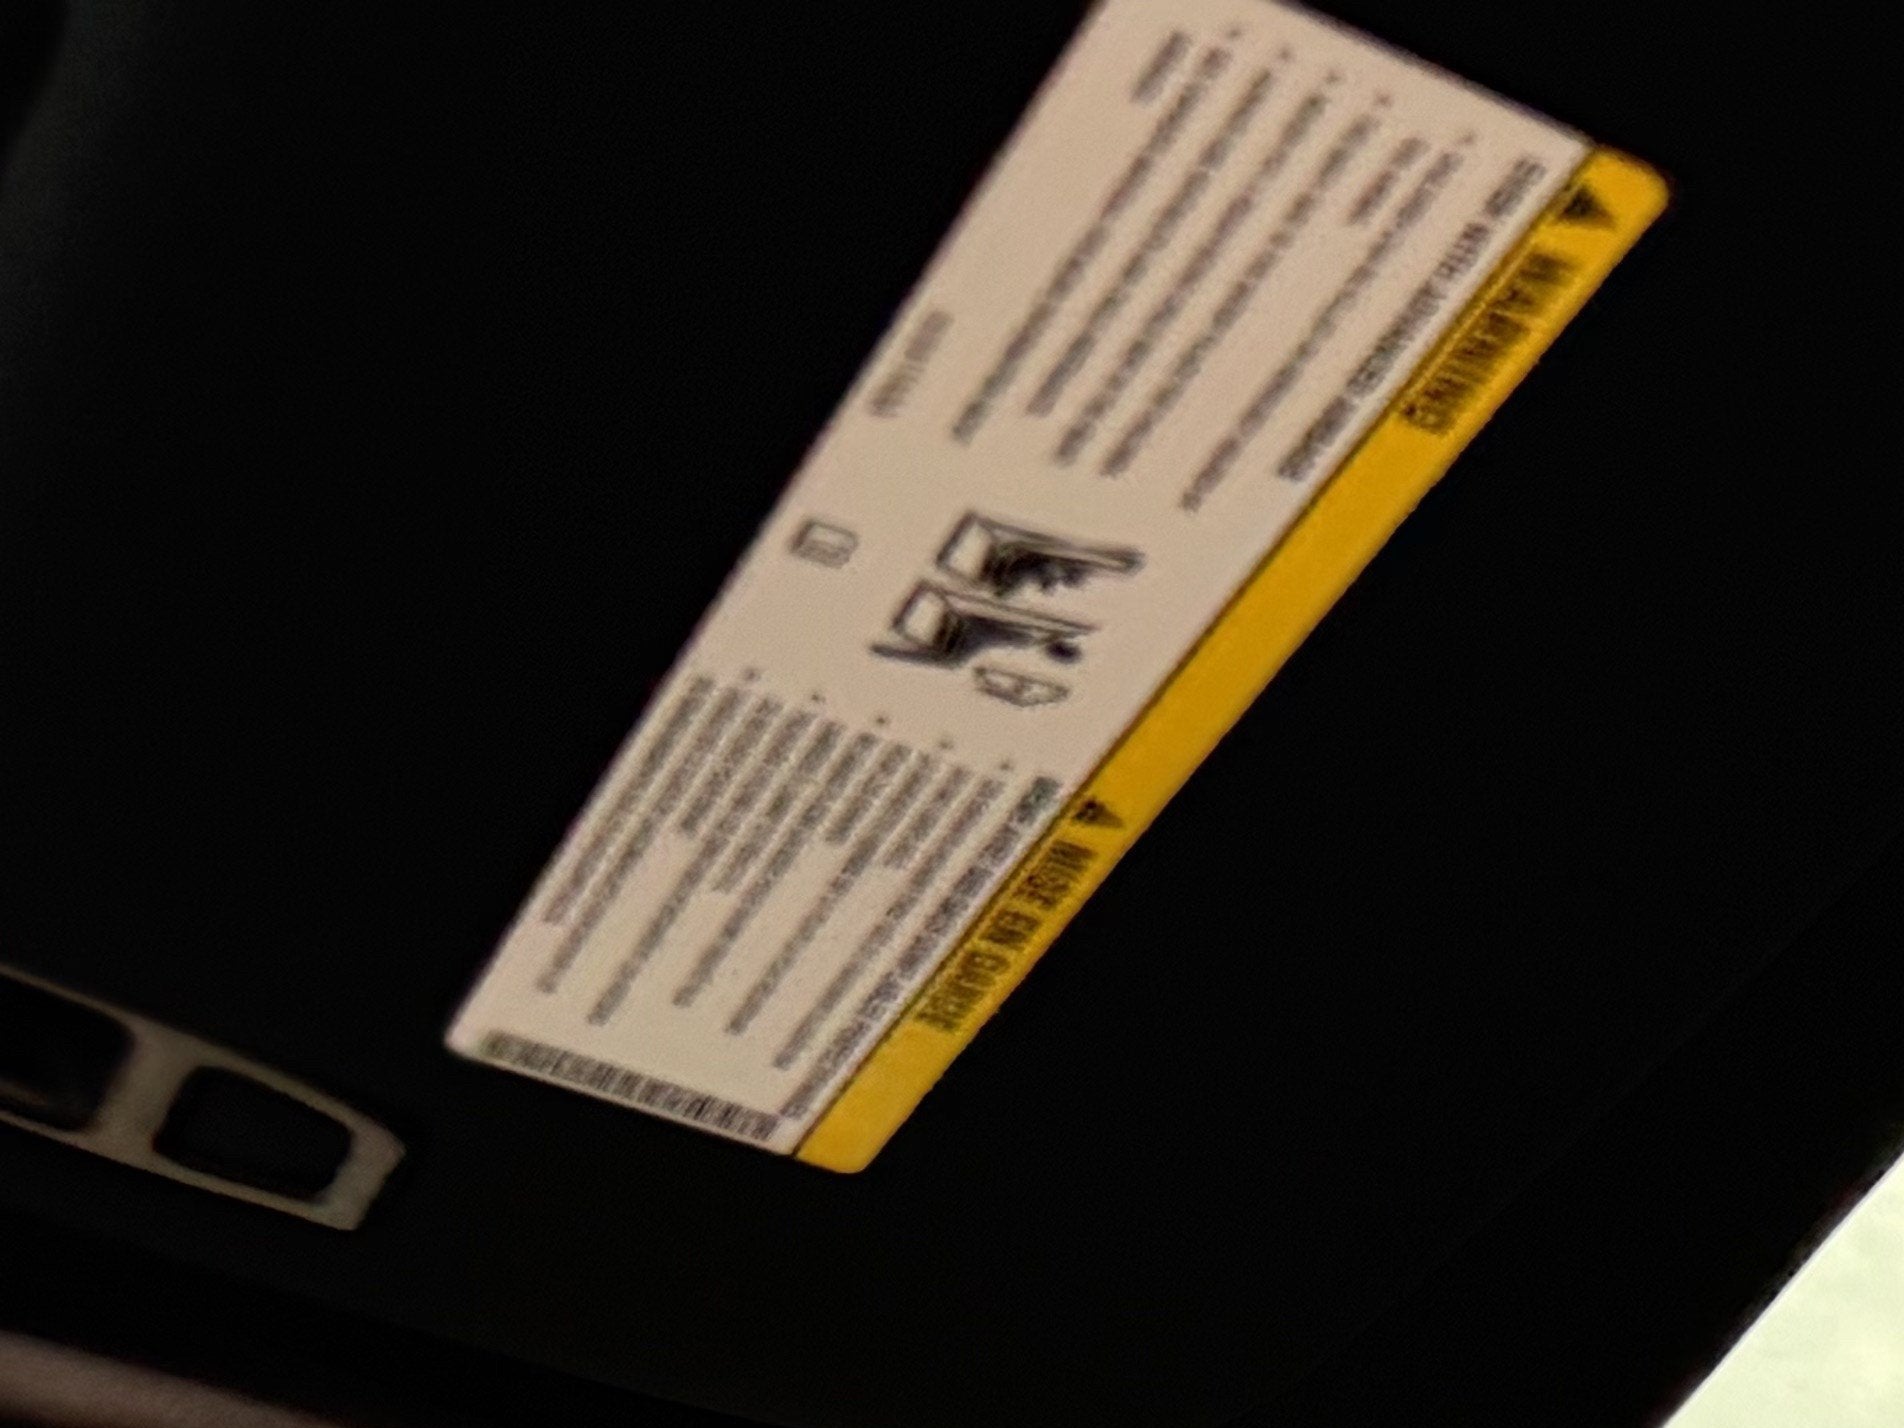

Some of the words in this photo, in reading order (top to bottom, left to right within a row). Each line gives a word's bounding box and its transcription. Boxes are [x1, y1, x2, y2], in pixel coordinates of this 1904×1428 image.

[1399, 249, 1574, 436] WARNING
[1013, 839, 1098, 910] MISE
[981, 909, 1041, 952] EN
[914, 949, 1011, 1033] GARDE
